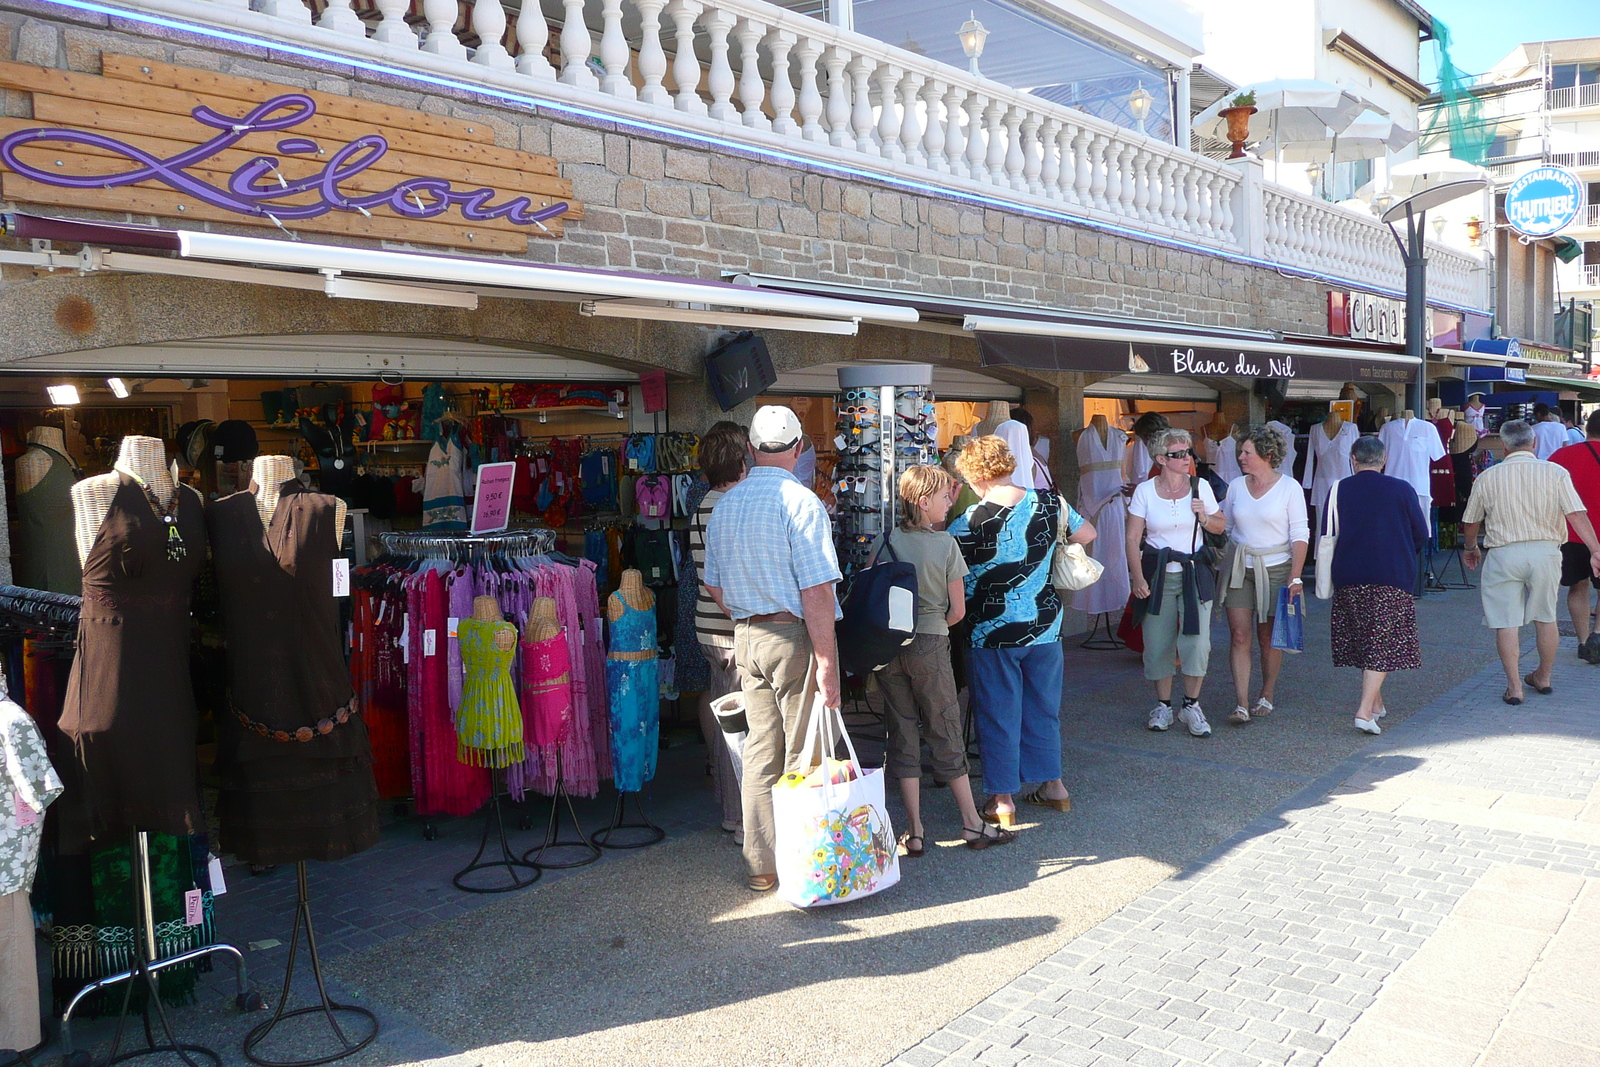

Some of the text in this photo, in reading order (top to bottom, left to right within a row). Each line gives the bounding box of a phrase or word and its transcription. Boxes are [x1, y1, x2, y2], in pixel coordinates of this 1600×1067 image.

[1, 94, 570, 225] Lilou
[1511, 169, 1574, 198] RESTAURANT
[1170, 348, 1296, 378] Blanc du Nil
[1360, 367, 1372, 377] mon
[1372, 365, 1393, 379] fascinant
[486, 492, 497, 502] 9,50
